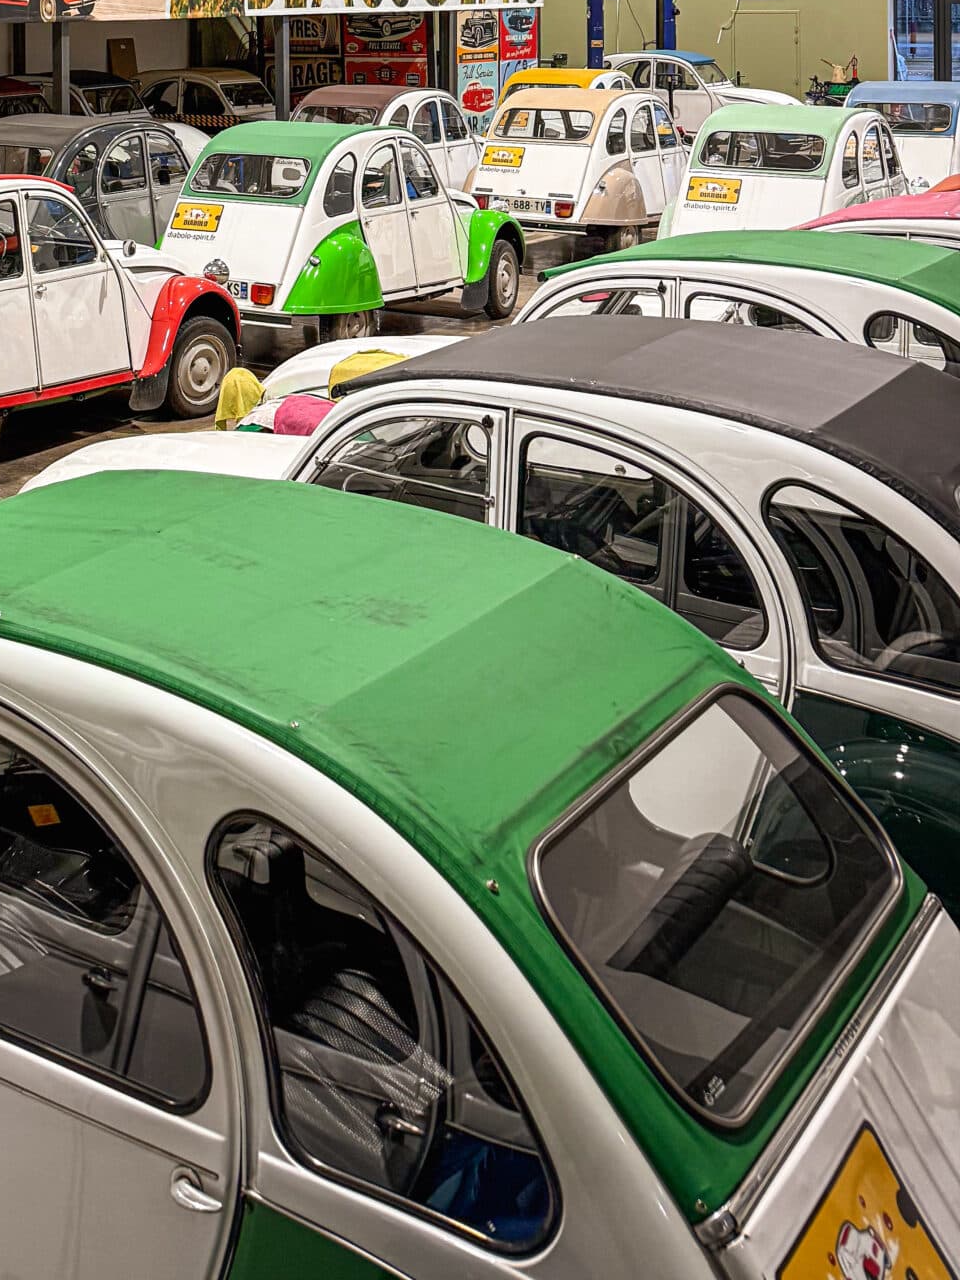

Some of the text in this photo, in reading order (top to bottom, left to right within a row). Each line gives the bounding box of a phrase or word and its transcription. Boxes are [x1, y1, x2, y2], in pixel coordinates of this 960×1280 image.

[289, 19, 319, 38] YRES
[683, 202, 737, 212] diabolo-spirit.fr
[183, 219, 209, 227] DIABOLO
[167, 231, 216, 241] diabolo-spirit.fr
